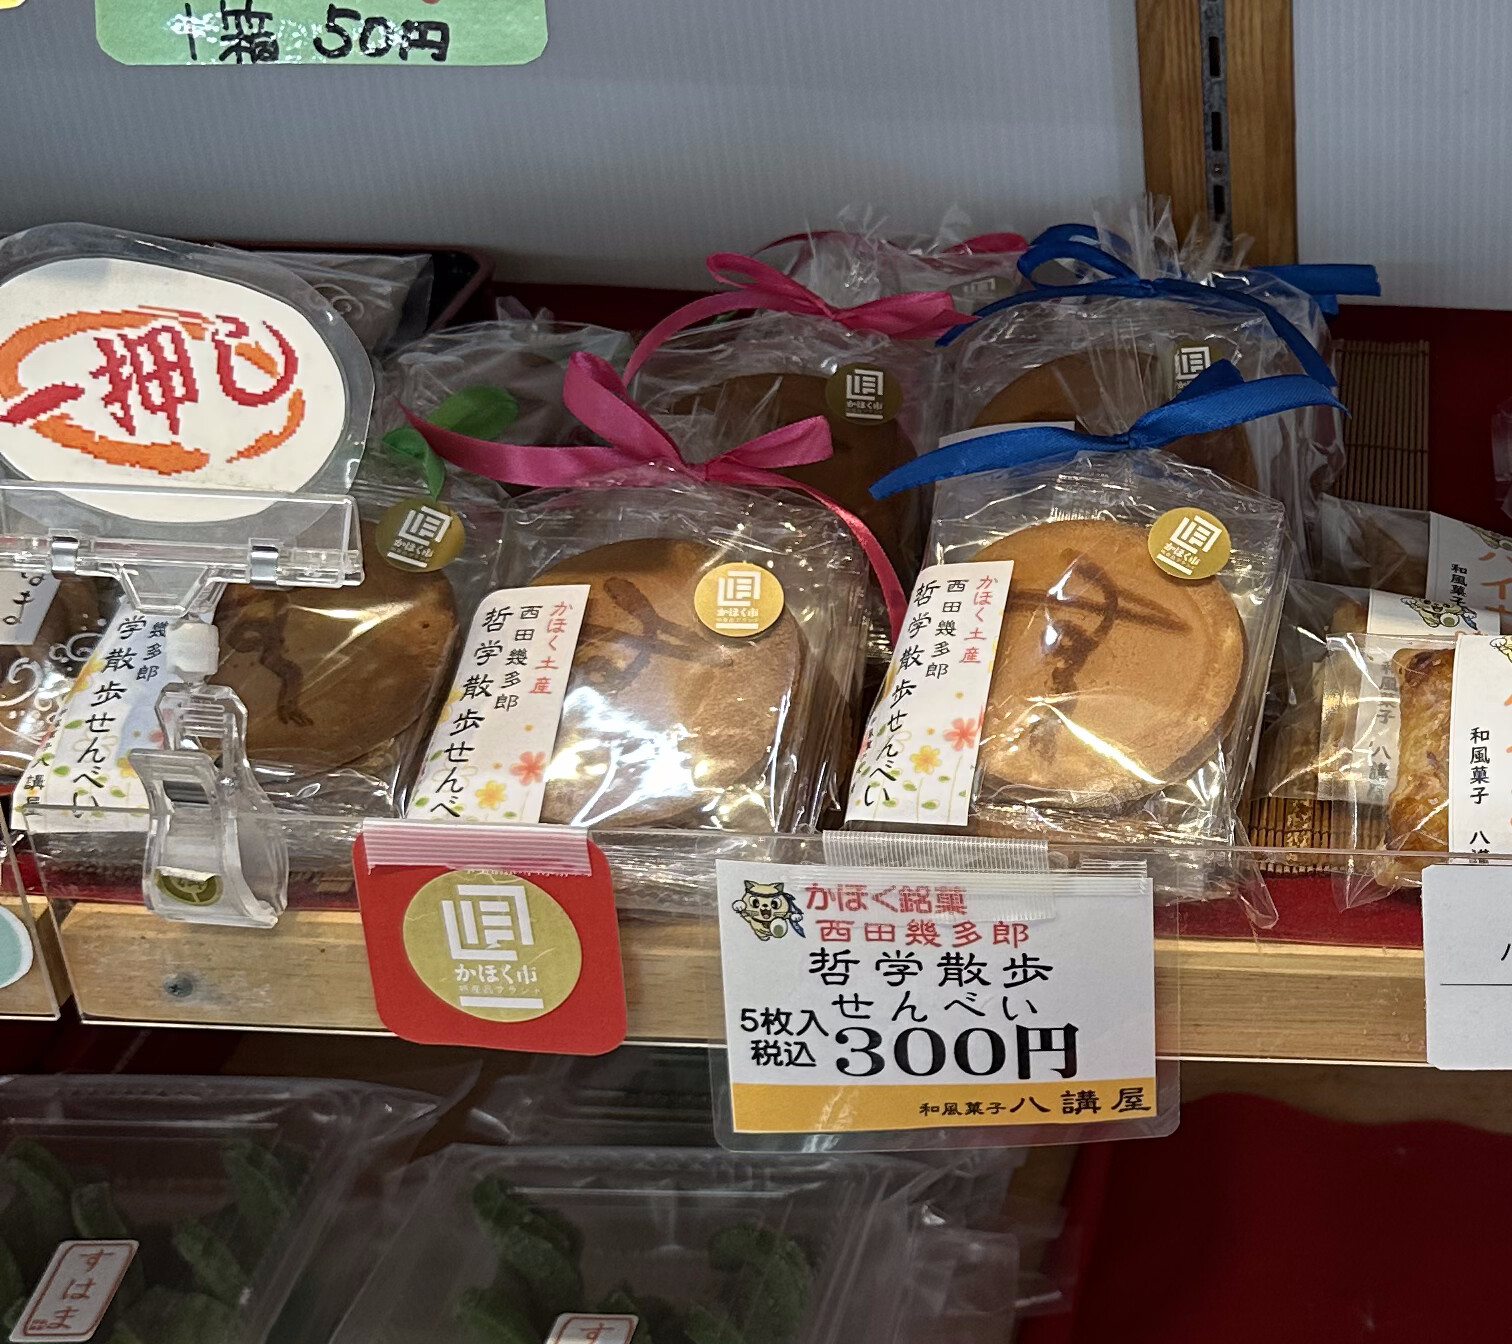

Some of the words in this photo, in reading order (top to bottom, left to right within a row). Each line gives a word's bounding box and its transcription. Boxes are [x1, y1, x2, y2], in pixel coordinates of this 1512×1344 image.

[312, 3, 451, 62] 50円
[0, 314, 299, 436] 一押し
[1449, 563, 1468, 606] 和風菓子
[528, 600, 573, 695] かほく土産
[924, 579, 970, 680] 西田幾多郎
[959, 574, 998, 664] かほく土産
[493, 605, 544, 712] 西田幾多郎
[863, 581, 941, 807] 哲学散歩せんべい
[1469, 727, 1491, 805] 和風菓子
[804, 882, 969, 916] かほく銘菓
[815, 920, 1030, 948] 西田幾多郎
[454, 963, 538, 985] かほく市
[808, 947, 1055, 989] 哲学散歩
[740, 1007, 830, 1037] 5枚入
[832, 991, 1038, 1023] せんべい
[750, 1040, 817, 1068] 税込
[834, 1022, 1080, 1081] 300円
[919, 1101, 1006, 1117] 和風菓子
[1009, 1086, 1152, 1116] 八講屋
[46, 1247, 115, 1331] すはま
